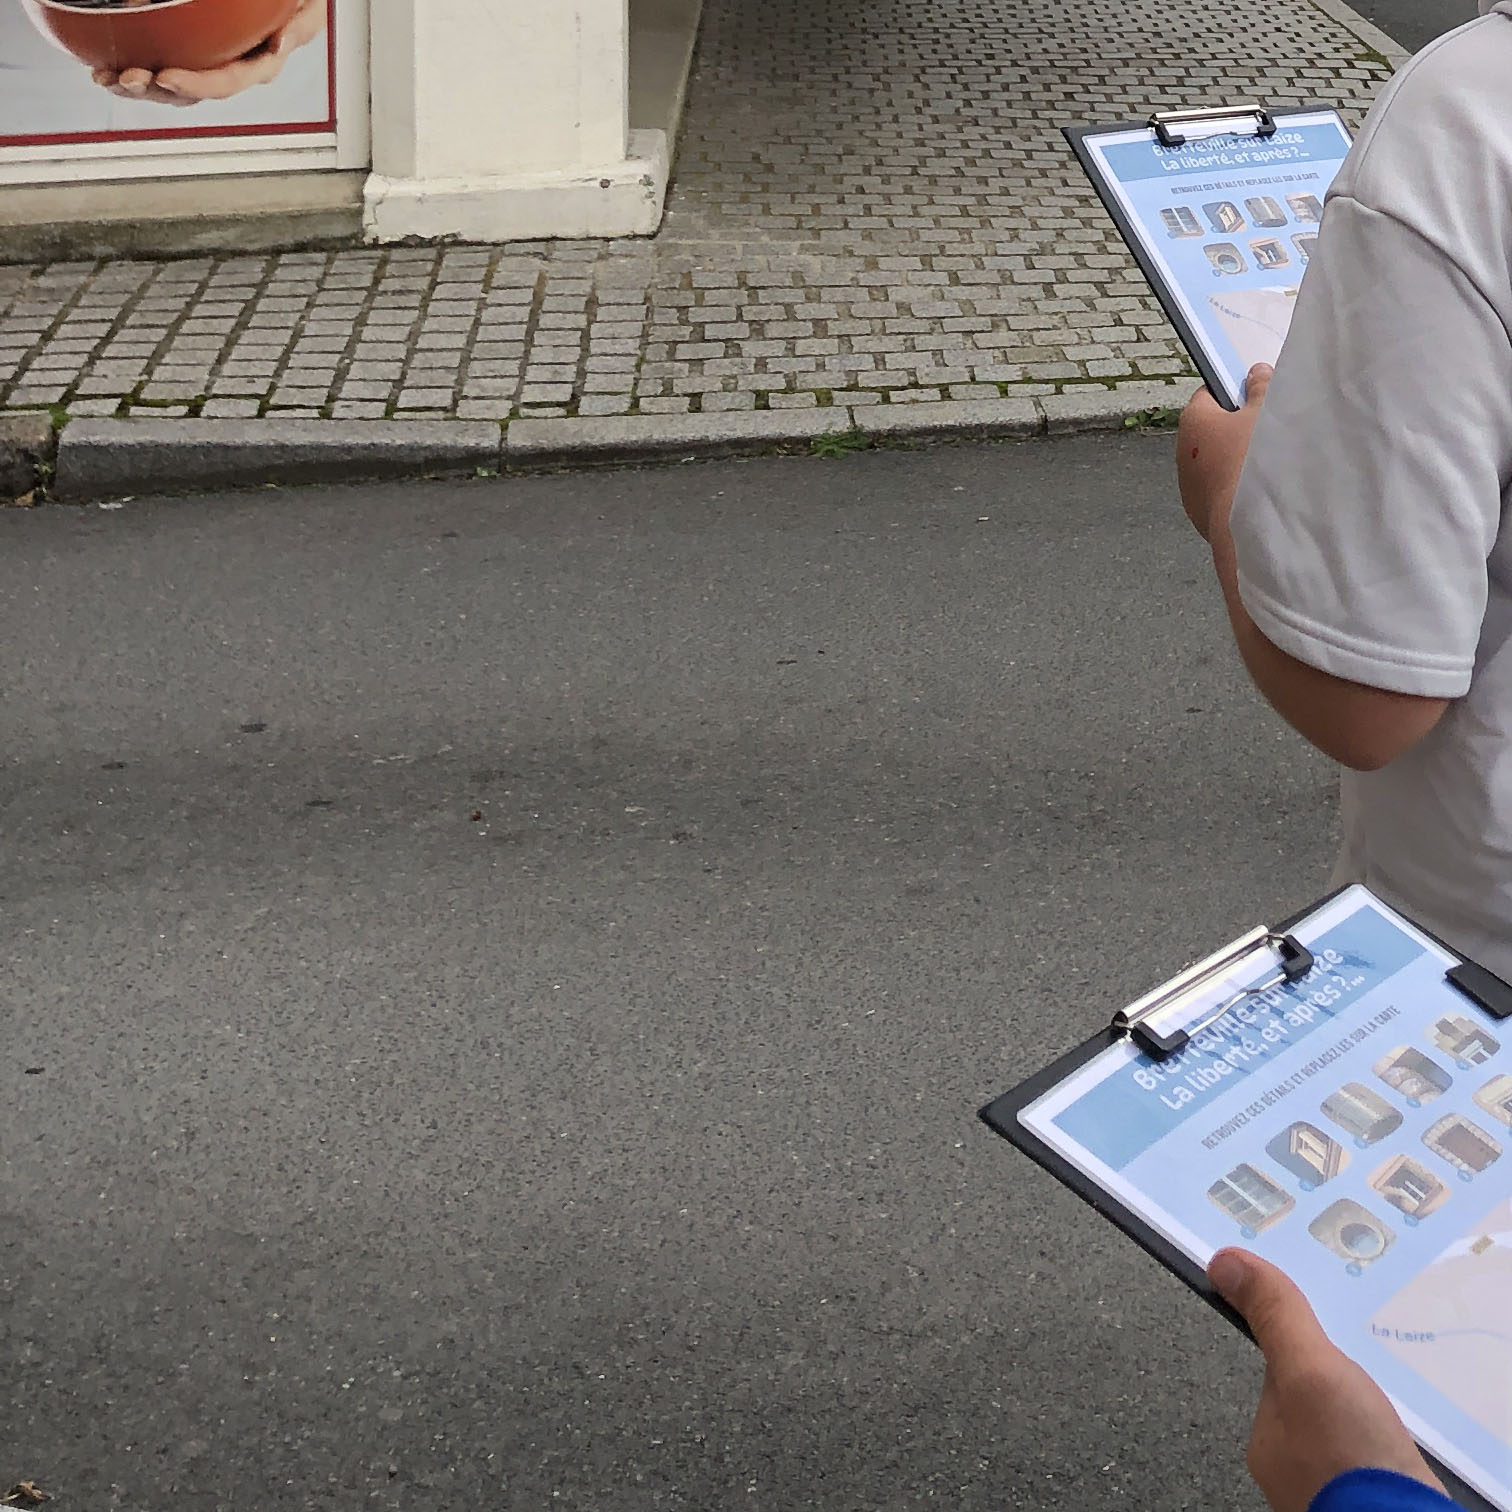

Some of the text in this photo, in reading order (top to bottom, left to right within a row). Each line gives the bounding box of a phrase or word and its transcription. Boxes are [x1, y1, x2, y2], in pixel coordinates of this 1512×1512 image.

[1161, 159, 1179, 171] La
[1234, 152, 1251, 164] et
[1160, 1086, 1196, 1111] La
[1261, 1018, 1289, 1042] et
[1283, 984, 1342, 1027] après
